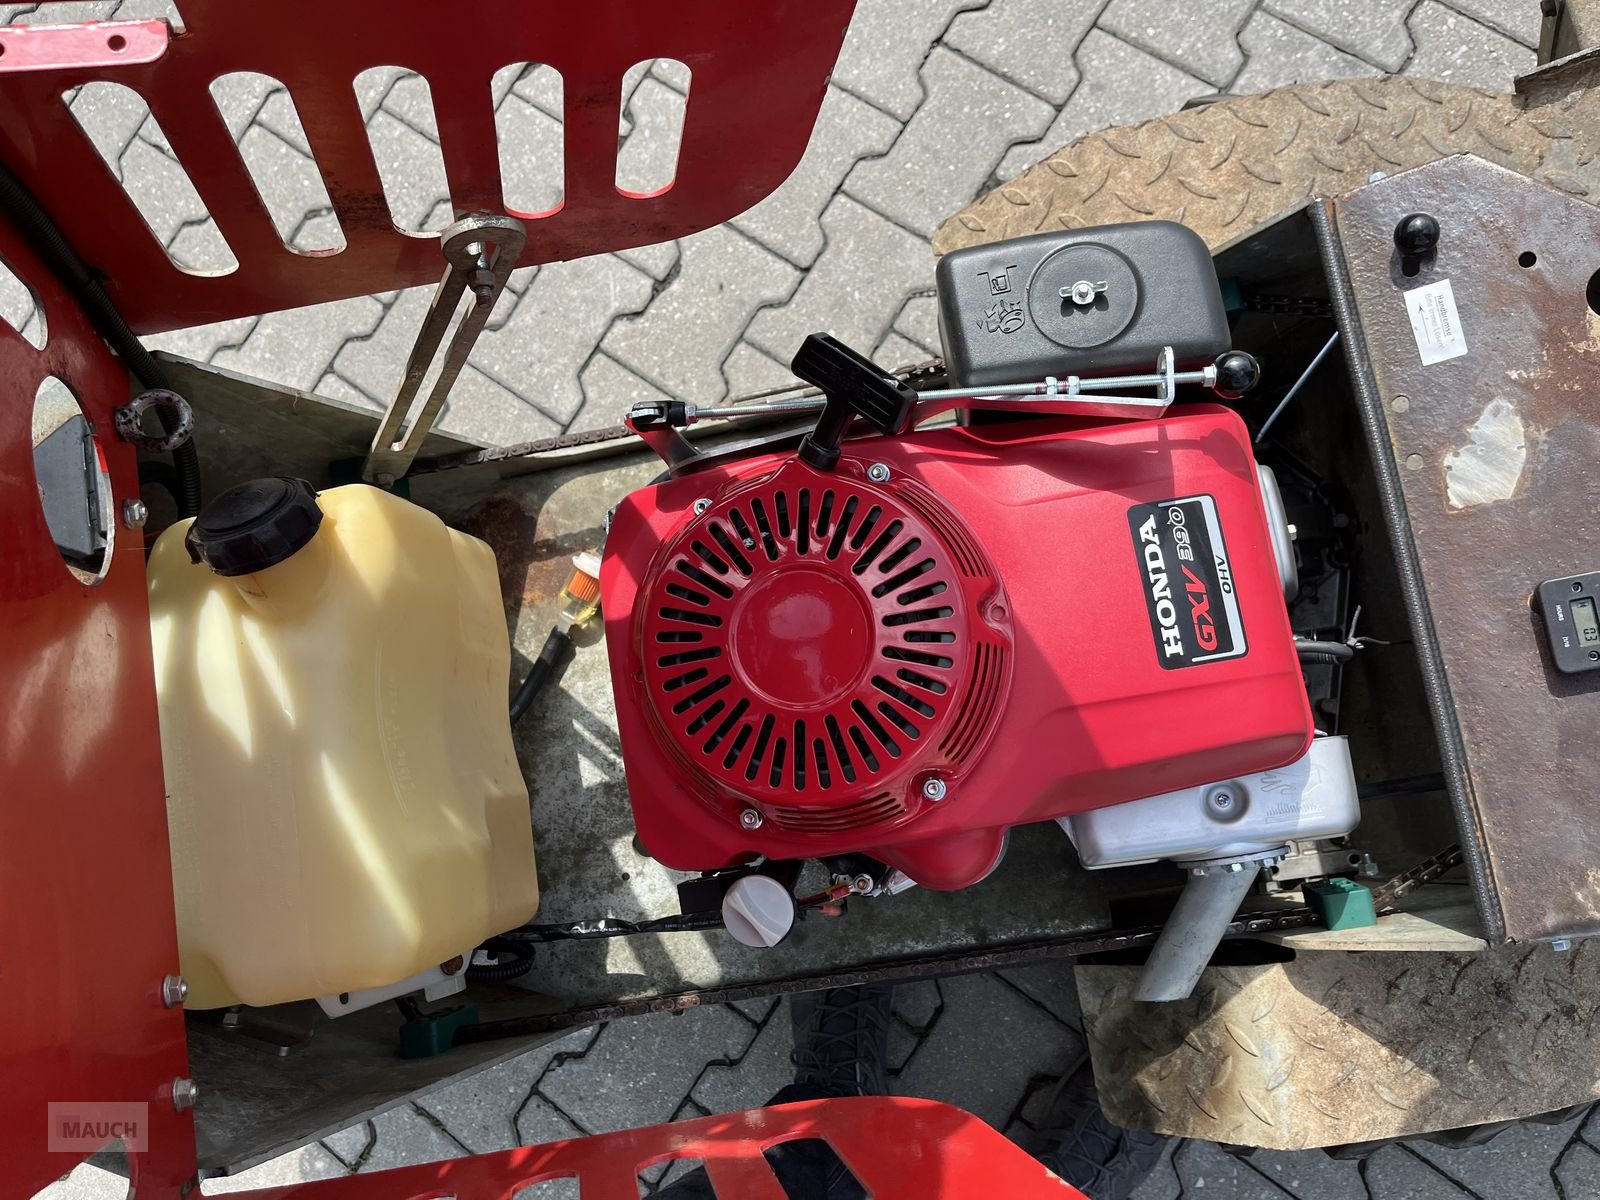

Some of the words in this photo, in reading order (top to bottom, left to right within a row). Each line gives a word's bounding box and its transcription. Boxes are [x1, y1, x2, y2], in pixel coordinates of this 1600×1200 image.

[1437, 294, 1452, 336] Handbremse
[1168, 506, 1194, 562] 390
[1139, 514, 1184, 658] HONDA
[1215, 555, 1232, 594] OHV
[1181, 564, 1218, 652] GXV
[1556, 604, 1565, 621] HOURS
